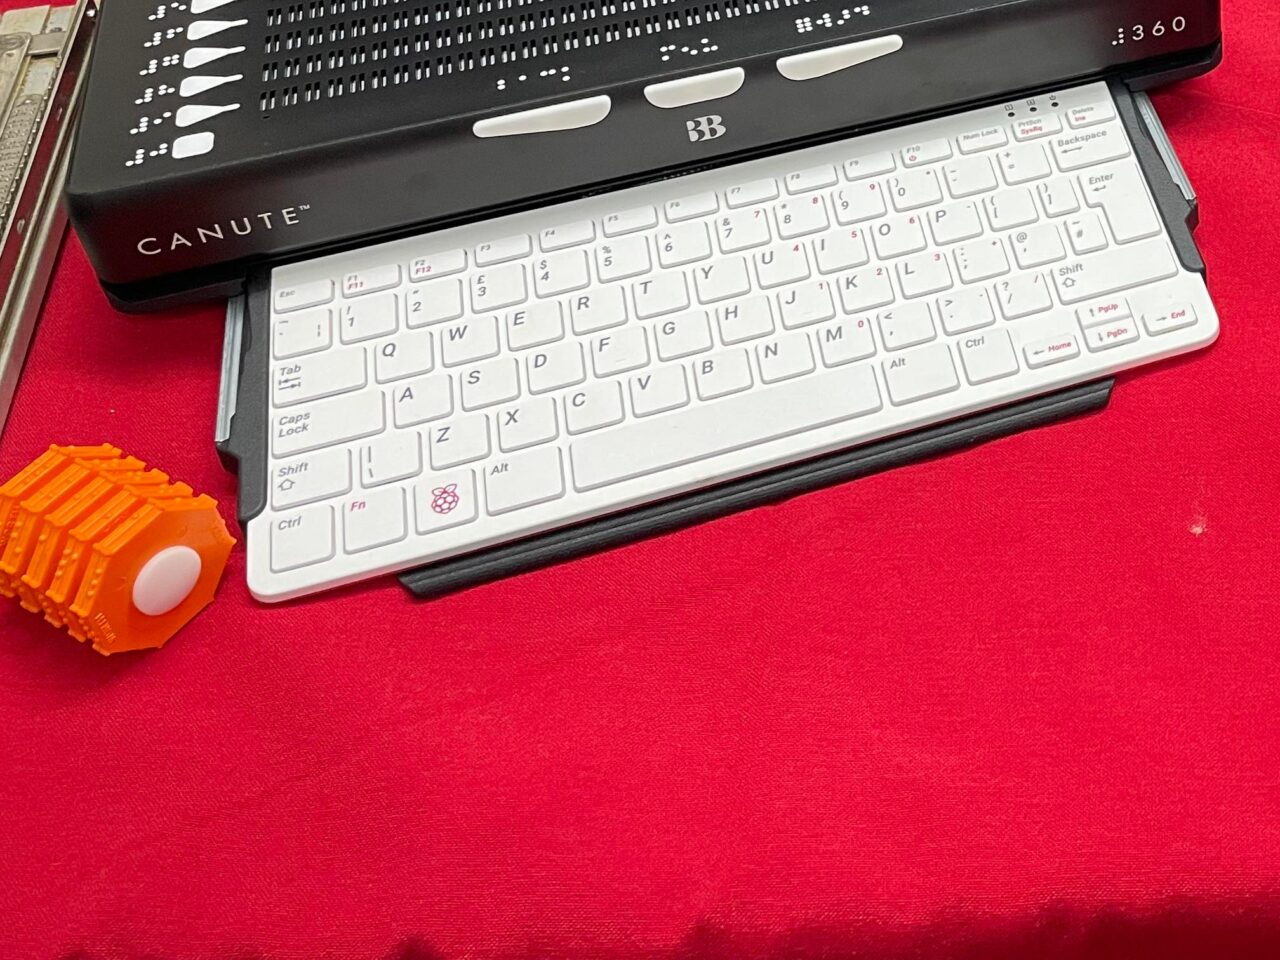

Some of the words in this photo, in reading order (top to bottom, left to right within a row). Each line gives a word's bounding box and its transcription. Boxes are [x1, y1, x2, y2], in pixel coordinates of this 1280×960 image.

[1071, 105, 1094, 115] Delete
[980, 127, 998, 136] Lock
[1056, 128, 1107, 148] Backspace
[1089, 174, 1113, 184] Enter
[936, 210, 946, 223] P
[879, 224, 891, 236] O
[762, 251, 773, 264] U
[415, 265, 432, 274] F12
[701, 266, 713, 279] Y
[905, 263, 915, 275] L
[1059, 264, 1083, 276] Shift
[640, 281, 652, 294] T
[846, 275, 857, 289] K
[578, 296, 589, 310] R
[785, 291, 795, 304] J
[514, 311, 525, 326] E
[725, 305, 737, 320] H
[1171, 310, 1185, 319] End
[449, 325, 467, 341] W
[663, 322, 675, 335] G
[826, 326, 842, 342] M
[1107, 329, 1129, 340] PgDn
[599, 337, 610, 352] F
[966, 336, 984, 348] Ctrl
[1048, 342, 1071, 352] Home
[382, 343, 396, 357] Q
[765, 343, 777, 358] N
[534, 354, 547, 368] D
[702, 360, 713, 375] B
[890, 358, 905, 369] Alt
[280, 364, 301, 376] Tab
[468, 371, 480, 384] S
[638, 375, 651, 390] V
[399, 387, 413, 402] A
[573, 393, 585, 407] C
[279, 413, 310, 427] Caps
[505, 409, 519, 425] X
[278, 421, 309, 438] Lock
[436, 427, 450, 443] Z
[278, 463, 308, 477] Shift
[491, 463, 508, 475] Alt
[351, 501, 365, 511] Fn
[278, 516, 301, 530] Ctrl
